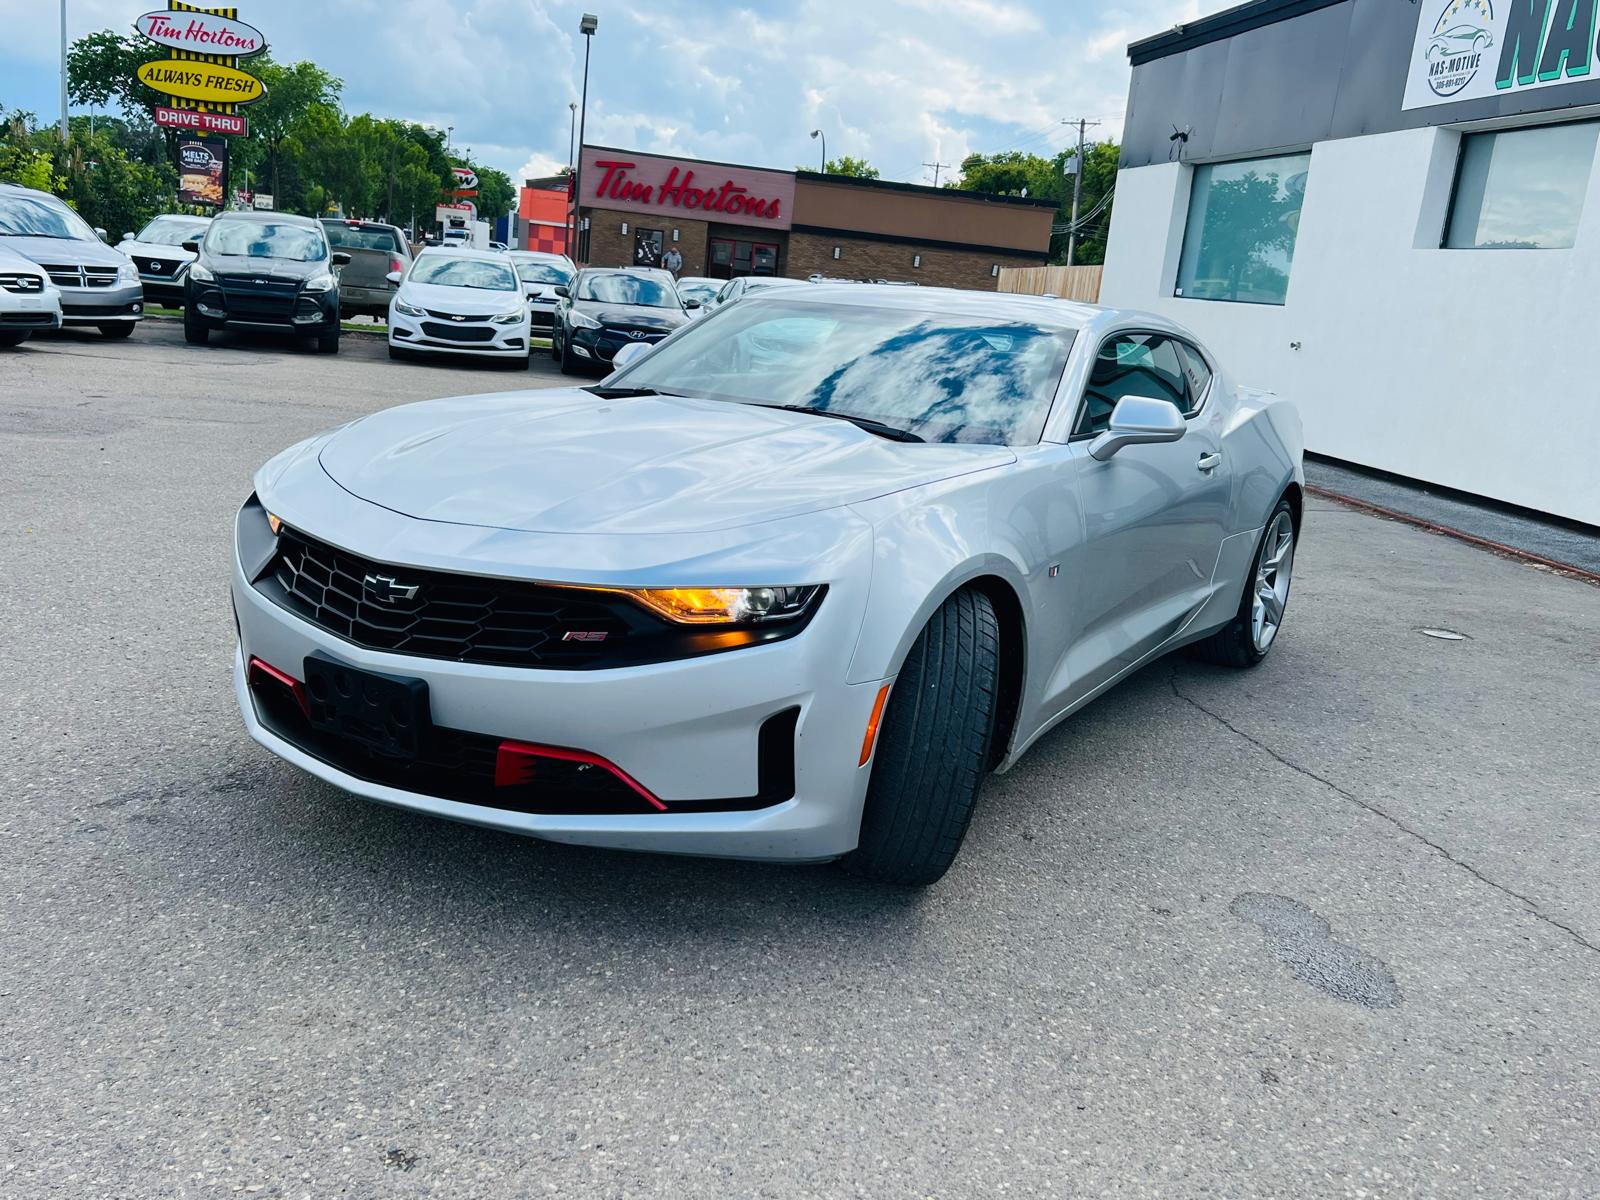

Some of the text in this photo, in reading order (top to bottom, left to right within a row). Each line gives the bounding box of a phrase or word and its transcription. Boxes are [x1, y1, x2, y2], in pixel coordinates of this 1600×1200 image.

[147, 15, 255, 50] Tim Hortons
[144, 67, 255, 93] ALWAYS FRESH
[158, 110, 241, 131] DRIVE THRU
[182, 150, 209, 160] MELTS
[595, 160, 781, 219] Tim Hortons
[561, 631, 609, 642] RS
